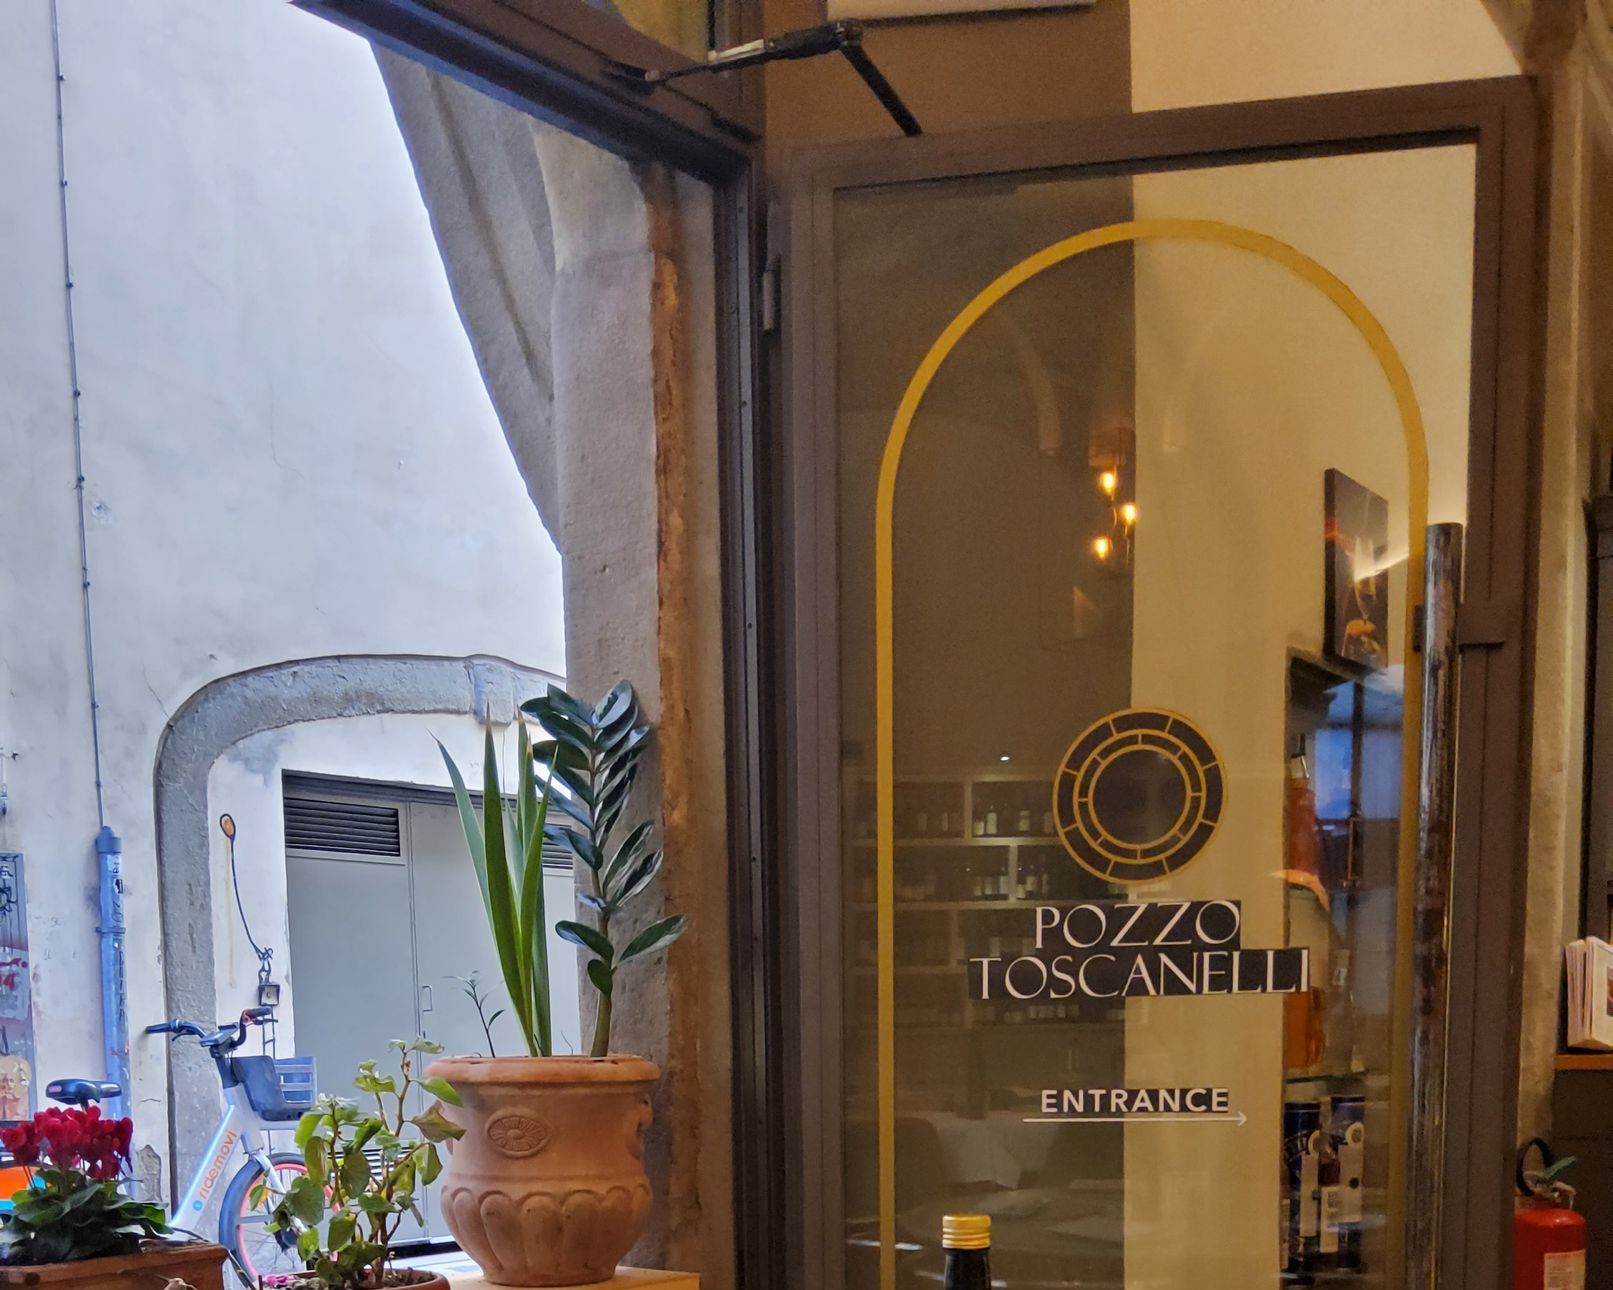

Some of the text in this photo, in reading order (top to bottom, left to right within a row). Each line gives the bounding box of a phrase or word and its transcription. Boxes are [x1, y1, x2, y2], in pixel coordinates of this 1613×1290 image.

[1035, 900, 1241, 949] POZZO
[969, 949, 1309, 1000] TOSCANELLI
[1041, 1087, 1230, 1113] ENTRANCE
[200, 1131, 238, 1200] ridemovi
